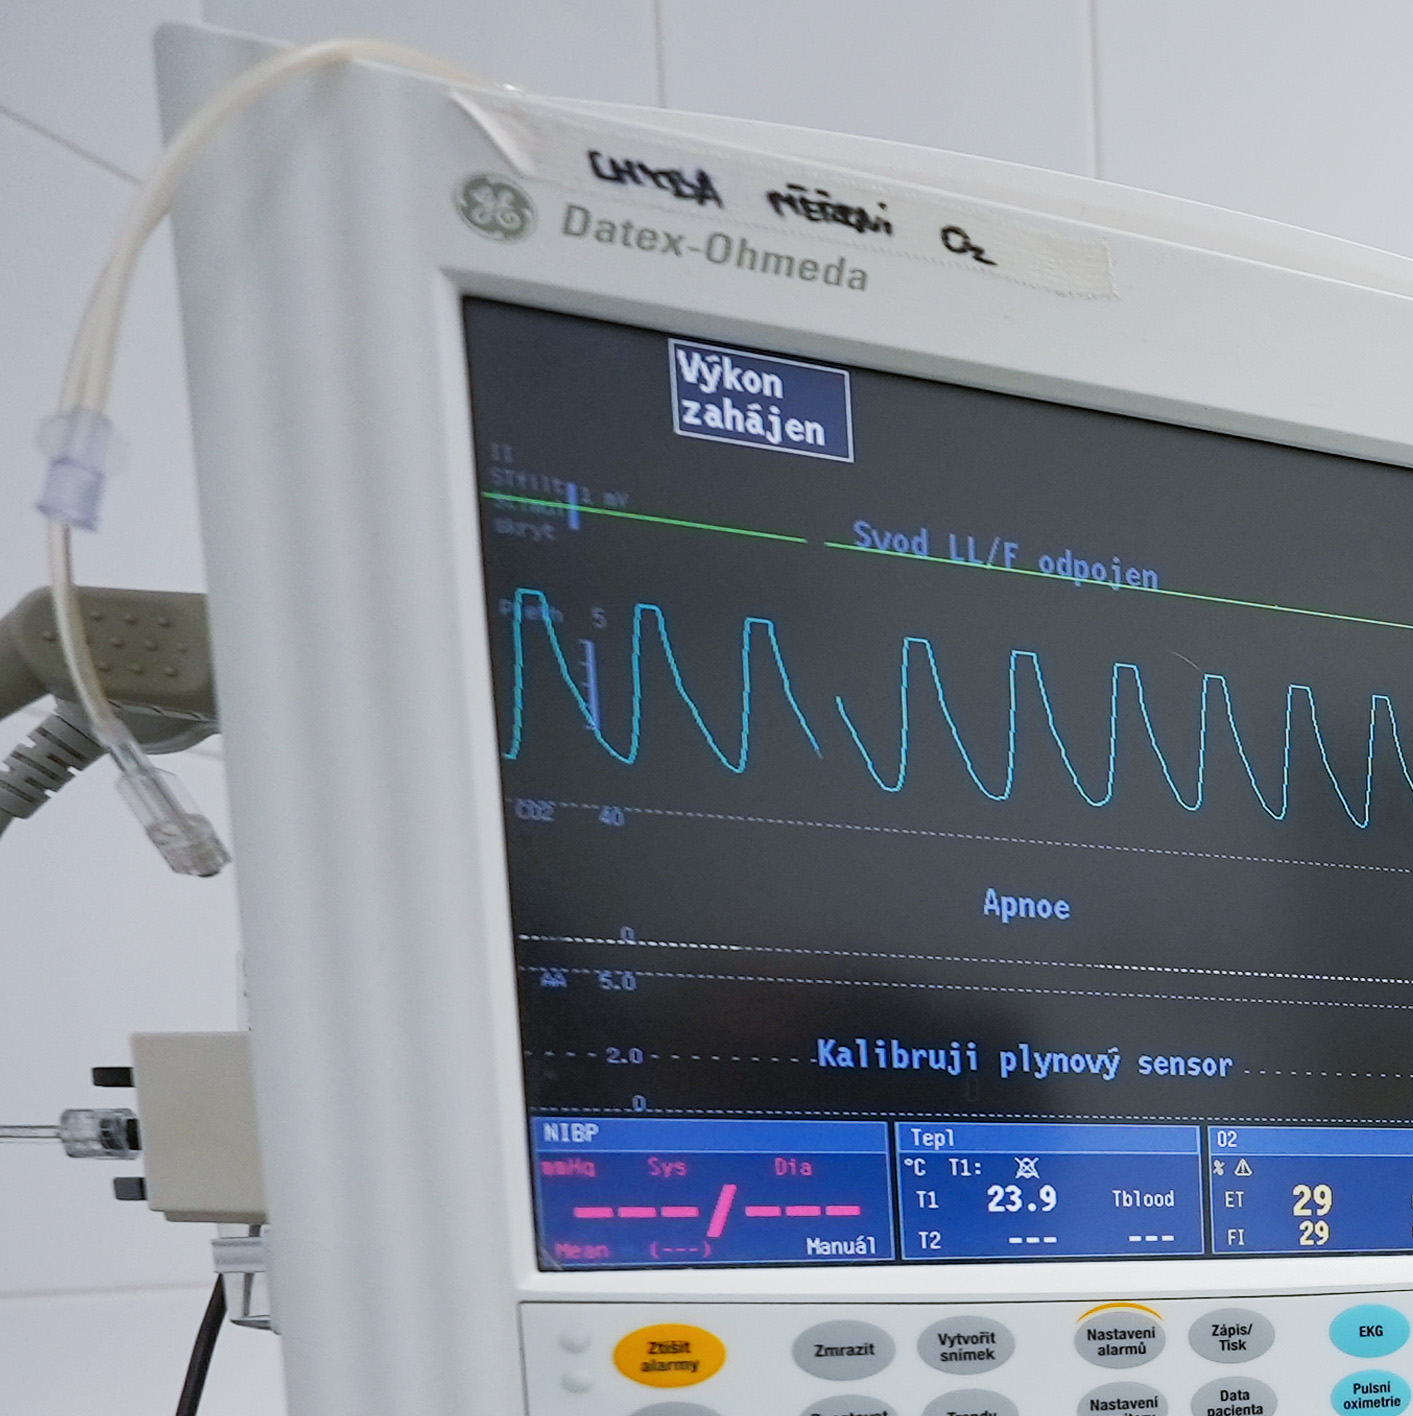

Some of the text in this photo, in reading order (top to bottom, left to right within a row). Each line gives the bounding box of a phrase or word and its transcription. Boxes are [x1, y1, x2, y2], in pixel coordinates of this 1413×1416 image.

[561, 203, 870, 293] Datex-Ohmeda
[675, 347, 784, 399] Výkon
[681, 396, 826, 449] zahájen
[852, 519, 1160, 590] Svod LL/F odpojen
[983, 888, 1071, 925] Apnoe
[599, 970, 637, 992] 5.0
[605, 1046, 644, 1066] 2.0
[816, 1037, 1235, 1082] Kalibruji plynový sensor
[543, 1122, 599, 1145] NIBP
[910, 1127, 955, 1149] Tepl
[647, 1156, 688, 1178] Sys
[774, 1156, 813, 1178] Dia
[948, 1158, 982, 1178] T1:
[916, 1184, 1176, 1213] T1 23.9 Tblood
[1292, 1184, 1334, 1217] 29
[917, 1230, 941, 1250] T2
[1299, 1221, 1330, 1246] 29
[806, 1235, 877, 1256] Manuál
[937, 1331, 996, 1348] Vytvořit
[1087, 1326, 1156, 1343] Nastavení
[1211, 1322, 1253, 1339] Zápis/
[1359, 1325, 1384, 1338] EKG
[814, 1342, 876, 1359] Zmrazit
[940, 1346, 996, 1363] snímek
[1097, 1342, 1147, 1357] alarmů
[1219, 1337, 1247, 1353] Tisk
[1219, 1388, 1250, 1403] Data
[1353, 1380, 1391, 1395] Pulsní
[1090, 1396, 1159, 1413] Nastavení
[1343, 1395, 1401, 1411] oximetrie
